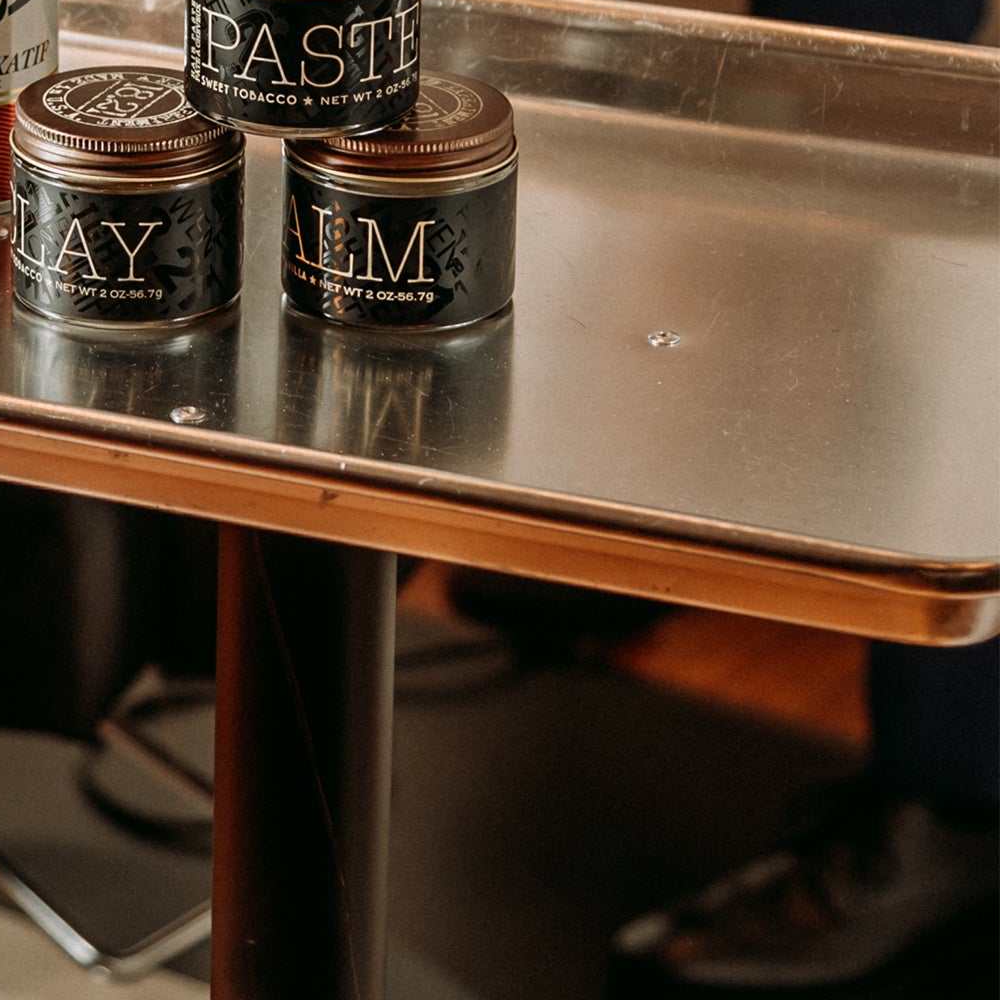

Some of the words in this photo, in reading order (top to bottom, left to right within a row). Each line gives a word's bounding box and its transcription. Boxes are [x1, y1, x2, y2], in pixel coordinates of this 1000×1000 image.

[202, 2, 419, 88] PASTE
[201, 75, 230, 95] SWEET
[232, 86, 297, 105] TOBACCO
[320, 94, 349, 106] NET
[352, 91, 373, 102] WT
[376, 89, 383, 99] 2
[282, 194, 435, 283] ALM
[55, 280, 77, 293] NET
[78, 285, 97, 297] WT
[100, 288, 107, 298] 2
[110, 289, 163, 300] OZ-56.7g
[319, 279, 342, 293] NET
[343, 285, 363, 298] WT
[365, 289, 374, 299] 2
[376, 291, 434, 303] OZ-56.7g
